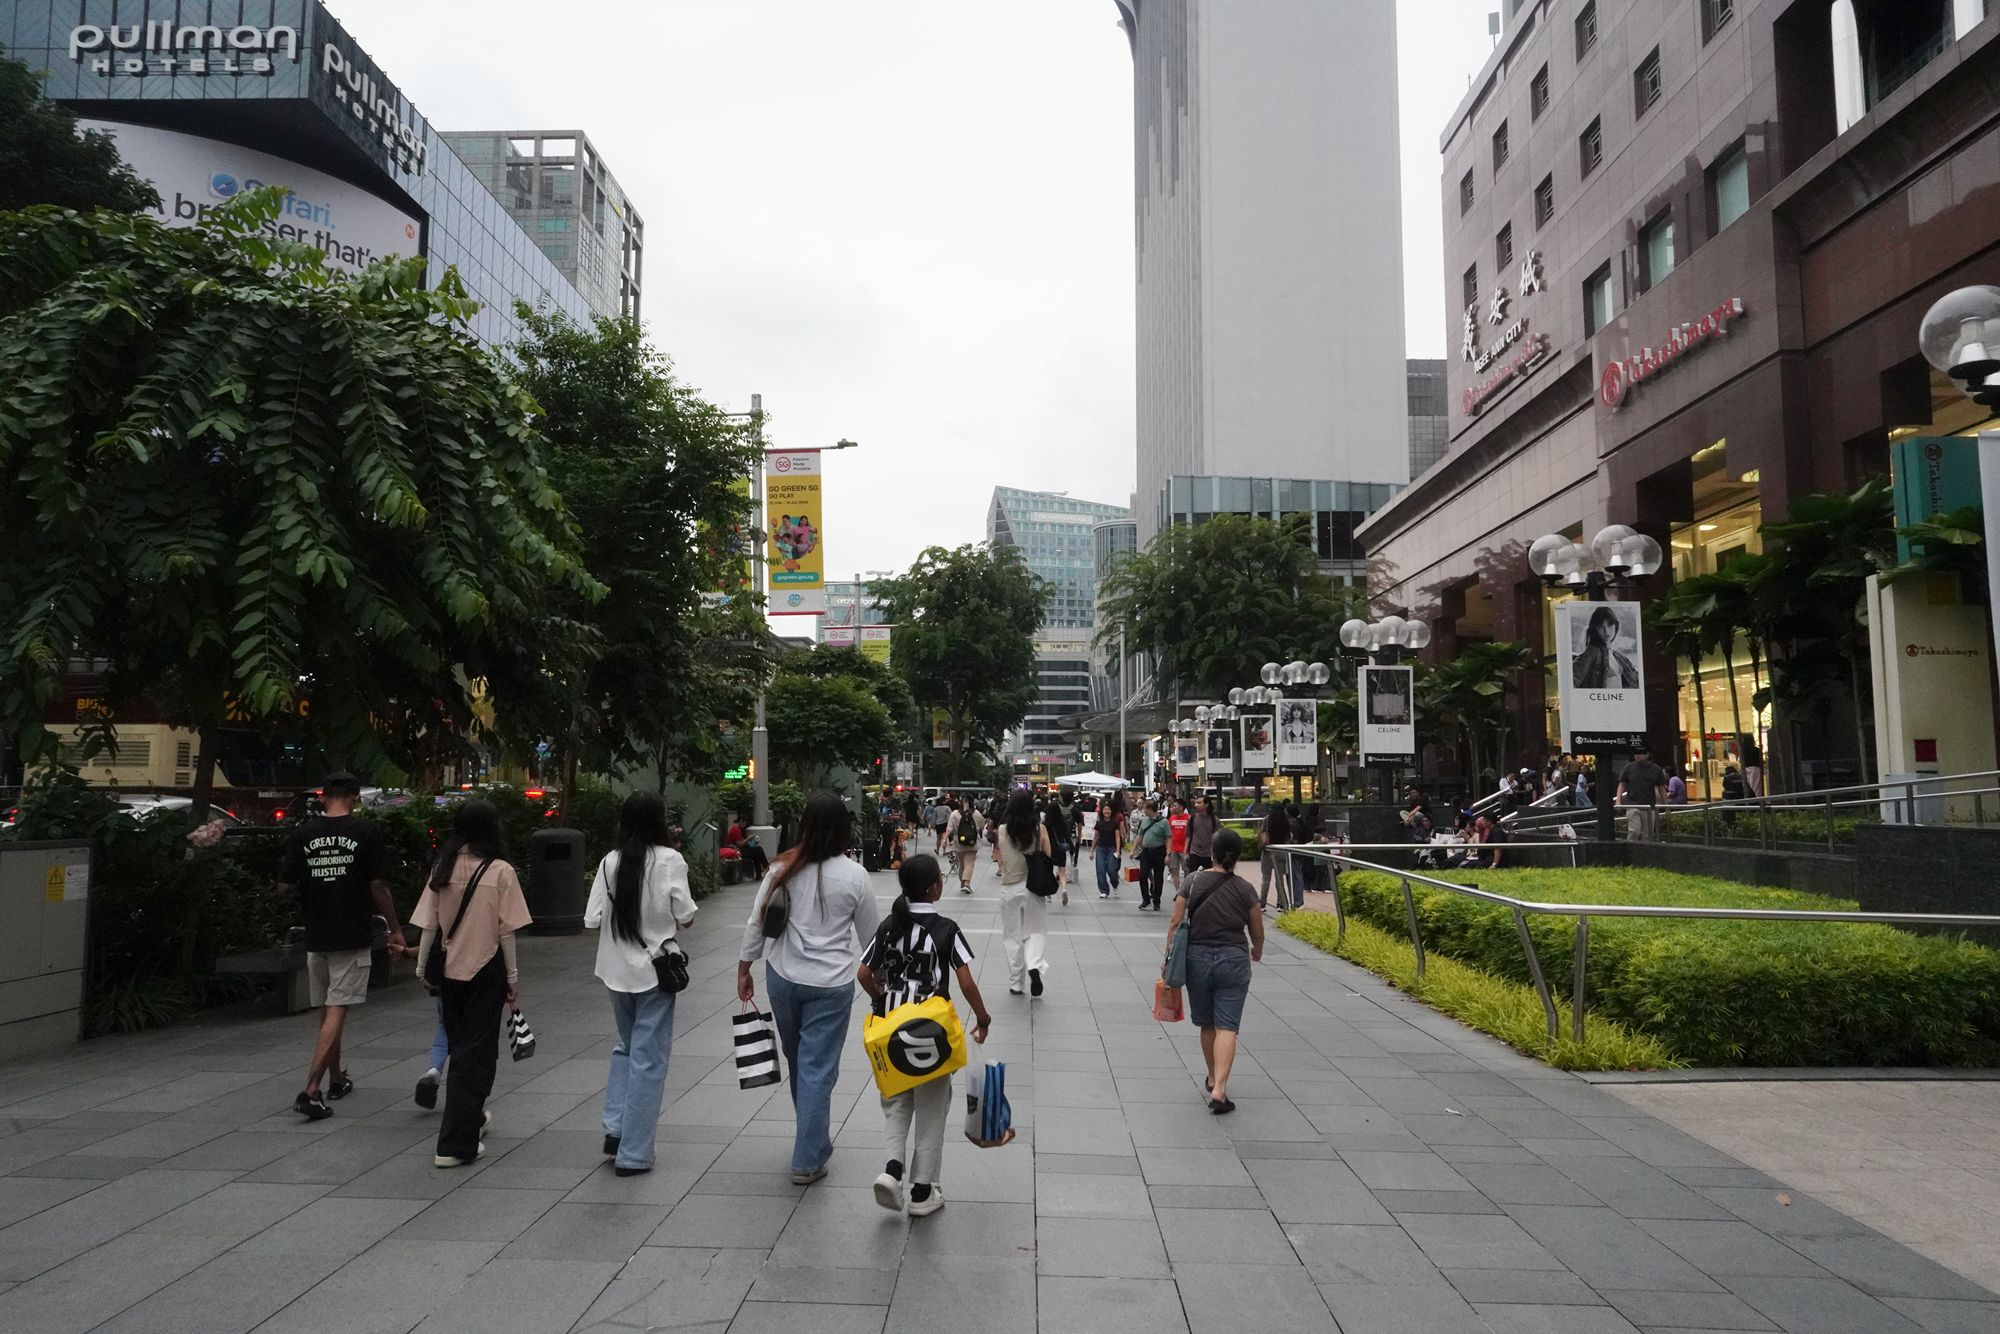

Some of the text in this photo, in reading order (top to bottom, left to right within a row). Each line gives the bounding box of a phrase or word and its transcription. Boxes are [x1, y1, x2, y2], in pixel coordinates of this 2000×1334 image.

[69, 20, 296, 59] pullman
[91, 58, 272, 73] HOTELS
[323, 43, 428, 177] pullman
[1474, 318, 1523, 374] NGEE ANN CITY
[1624, 298, 1743, 385] Takashimaya
[1919, 646, 1979, 658] Takashimaya
[1589, 693, 1624, 701] CELINE
[310, 836, 337, 850] GREAT
[338, 836, 358, 851] YEAR
[312, 866, 346, 877] HUSTLER
[898, 1030, 940, 1069] JD
